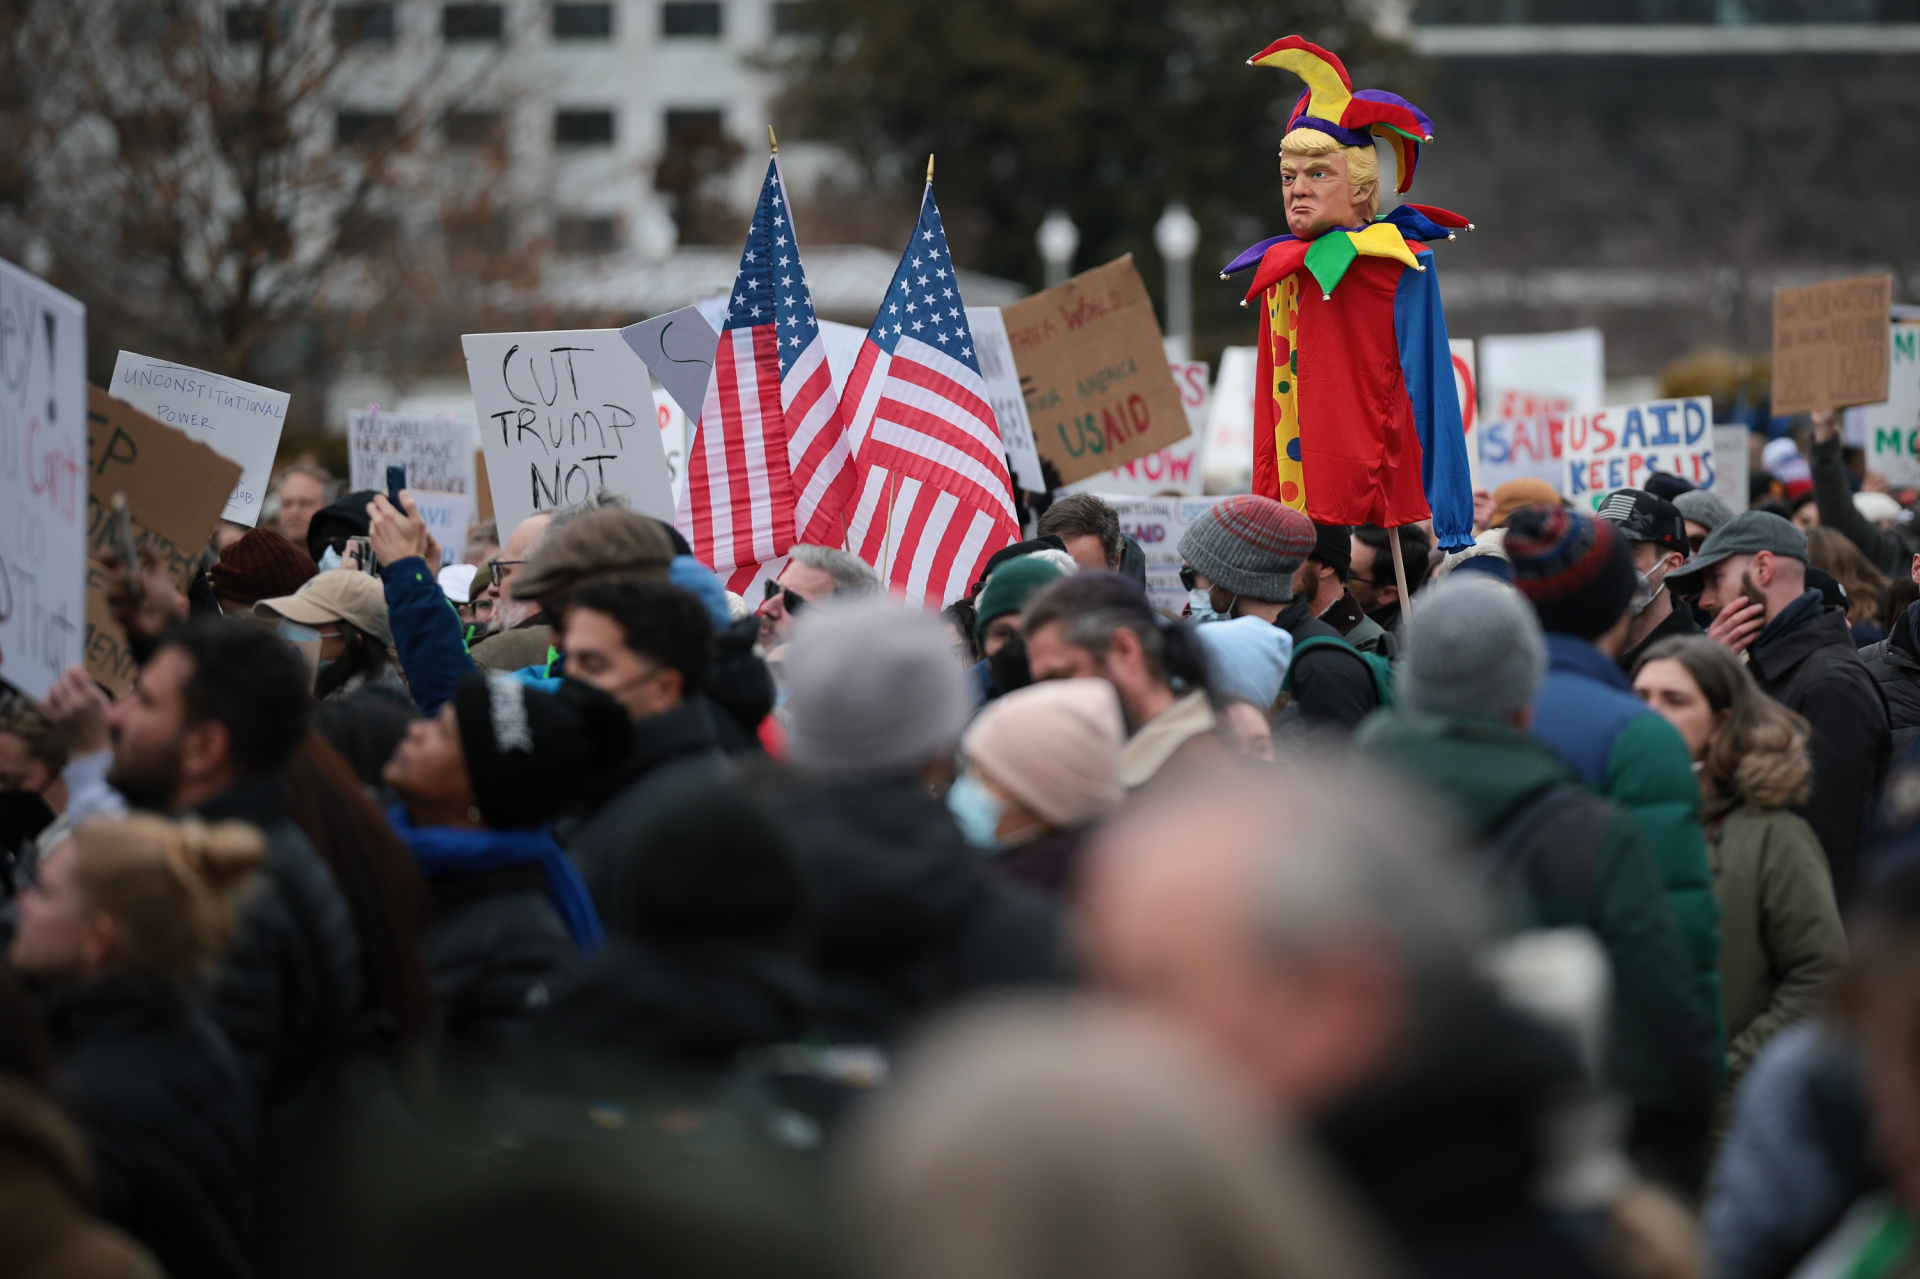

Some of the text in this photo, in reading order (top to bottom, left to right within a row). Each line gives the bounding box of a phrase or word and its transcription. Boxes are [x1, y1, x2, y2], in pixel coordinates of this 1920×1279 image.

[125, 368, 284, 418] UNCONSTITUTIONAL
[503, 345, 594, 406] CUT
[157, 405, 215, 430] POWER
[387, 418, 421, 437] WILL
[491, 404, 636, 455] TRUMP
[1058, 392, 1150, 458] USAID
[355, 435, 454, 459] NEVER HAVE
[531, 455, 617, 510] NOT
